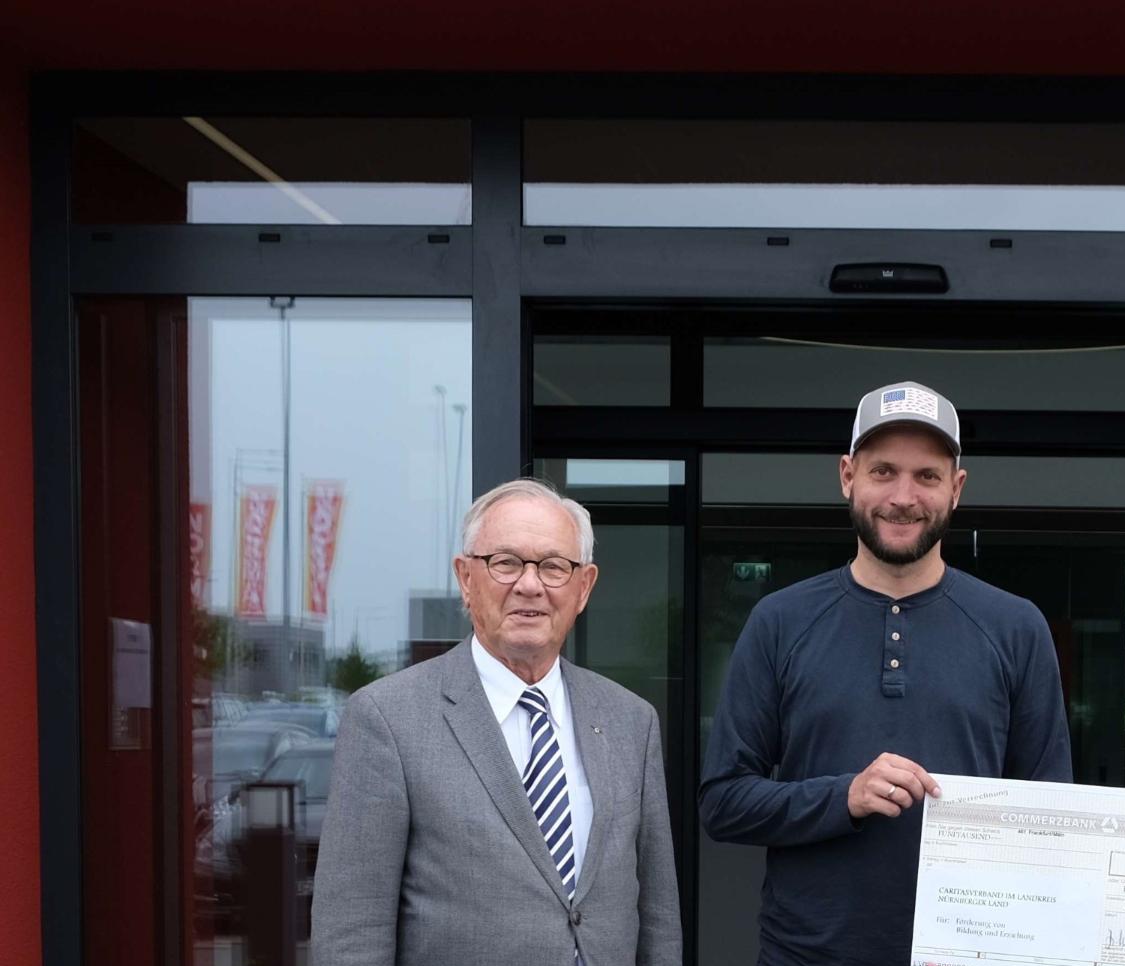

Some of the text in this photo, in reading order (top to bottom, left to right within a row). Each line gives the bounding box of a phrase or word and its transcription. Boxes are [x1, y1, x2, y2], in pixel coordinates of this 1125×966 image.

[1001, 813, 1097, 829] COMMERZBANK
[938, 896, 1009, 908] NÜRNBERGER LAND
[939, 887, 1003, 899] CARITASVERBAND
[1017, 894, 1057, 903] LANDKREIS
[956, 927, 983, 937] Bildung
